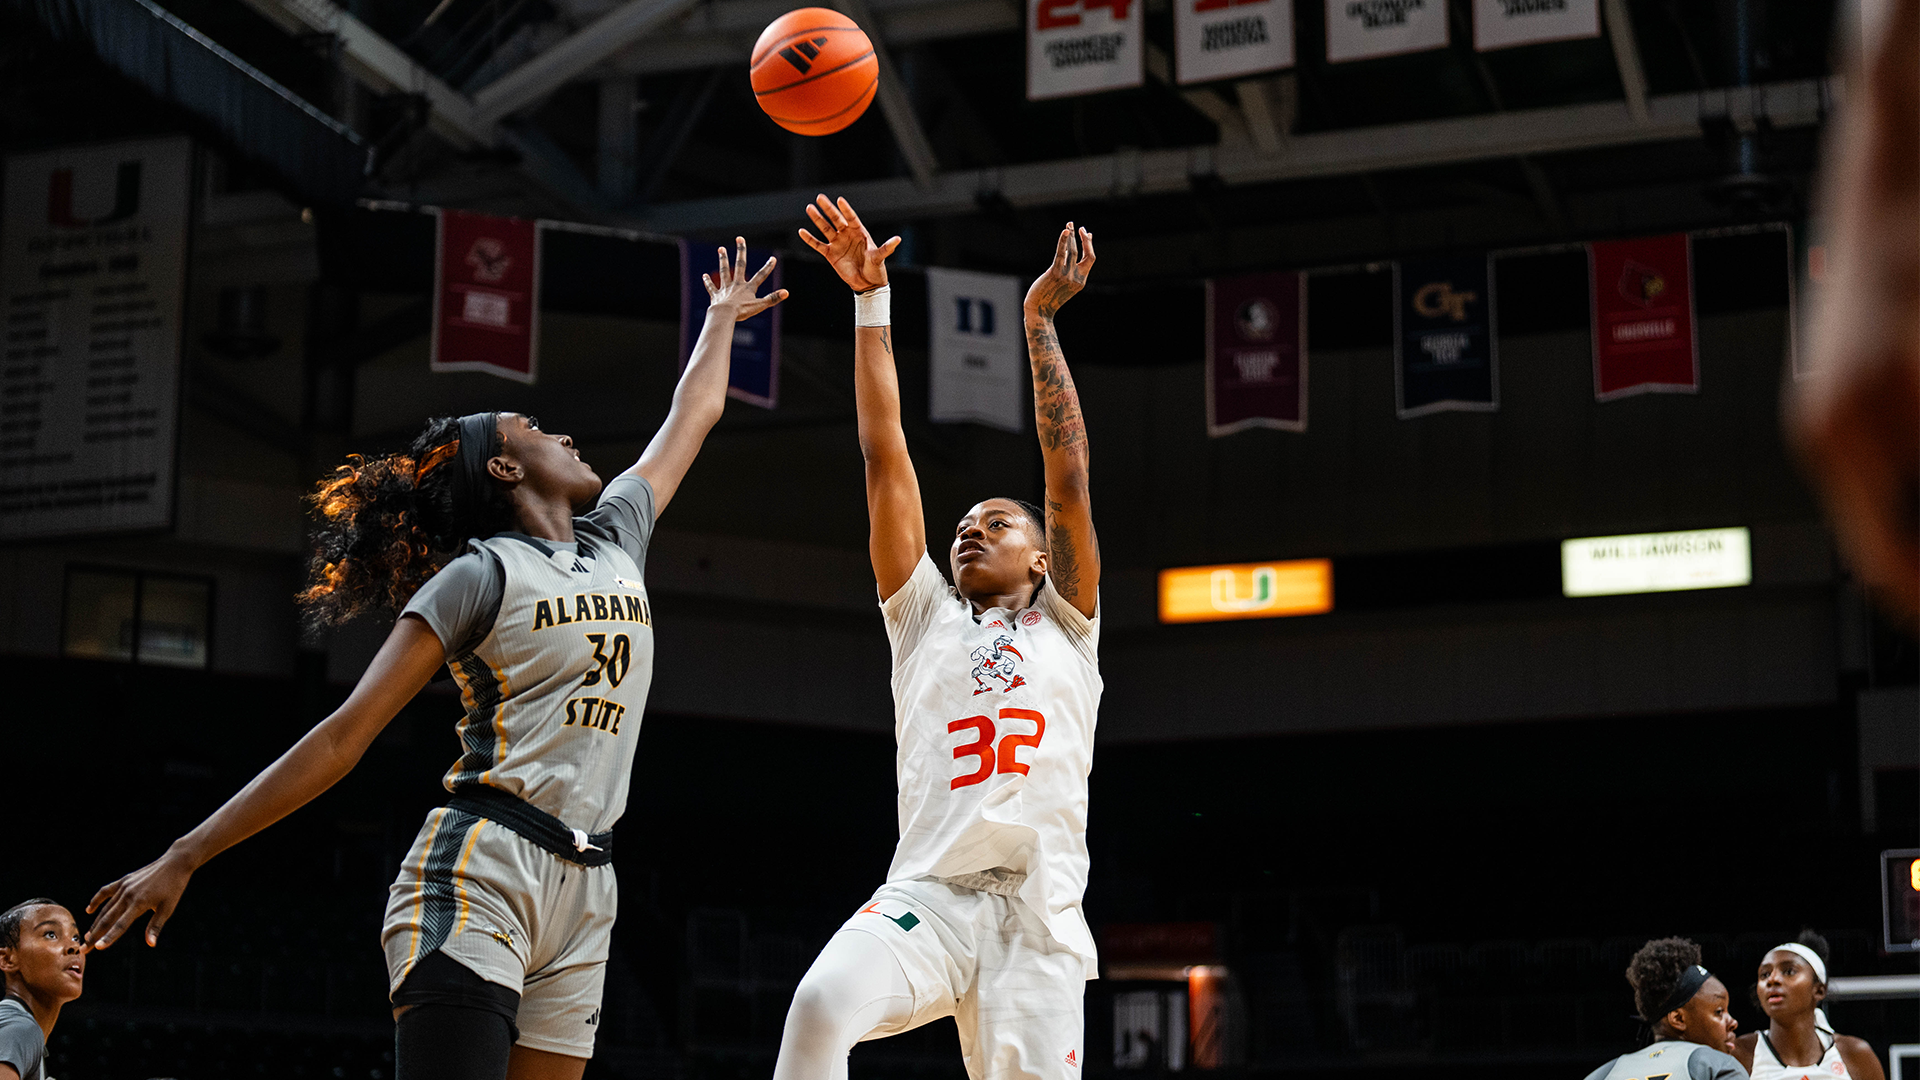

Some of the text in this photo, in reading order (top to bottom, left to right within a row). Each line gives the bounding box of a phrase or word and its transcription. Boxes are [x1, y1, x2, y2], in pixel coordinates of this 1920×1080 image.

[1210, 567, 1277, 612] U
[581, 633, 631, 688] 30
[947, 708, 1046, 791] 32
